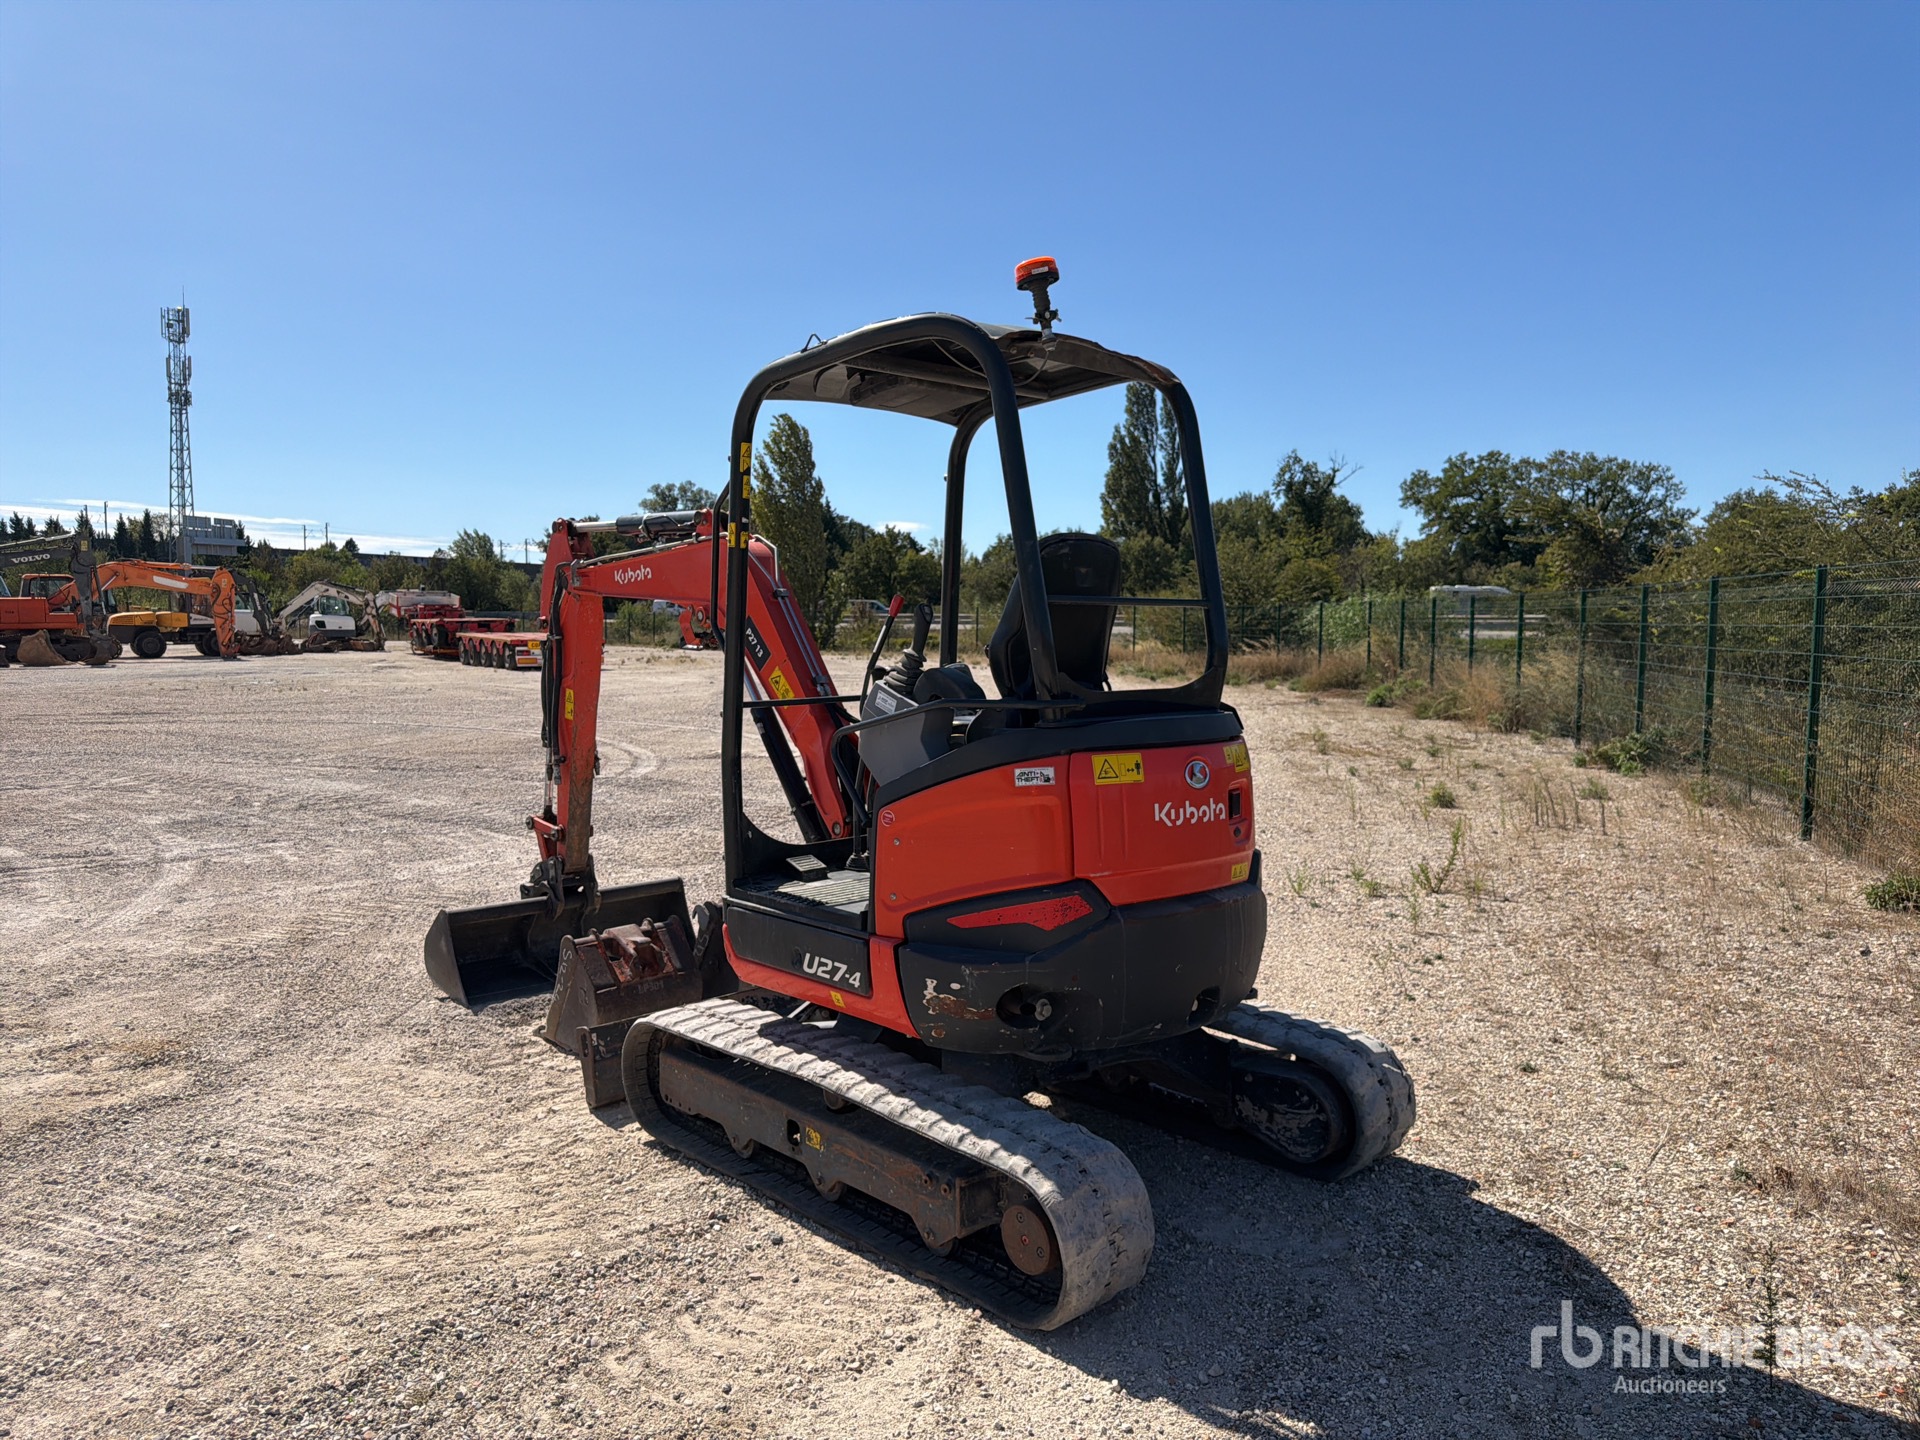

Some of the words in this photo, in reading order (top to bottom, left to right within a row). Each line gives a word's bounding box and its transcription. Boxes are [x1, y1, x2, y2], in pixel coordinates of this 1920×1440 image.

[11, 553, 51, 564] VOLVO
[614, 564, 652, 585] Kubota
[1154, 798, 1226, 827] Kubota
[802, 952, 861, 988] U27-4
